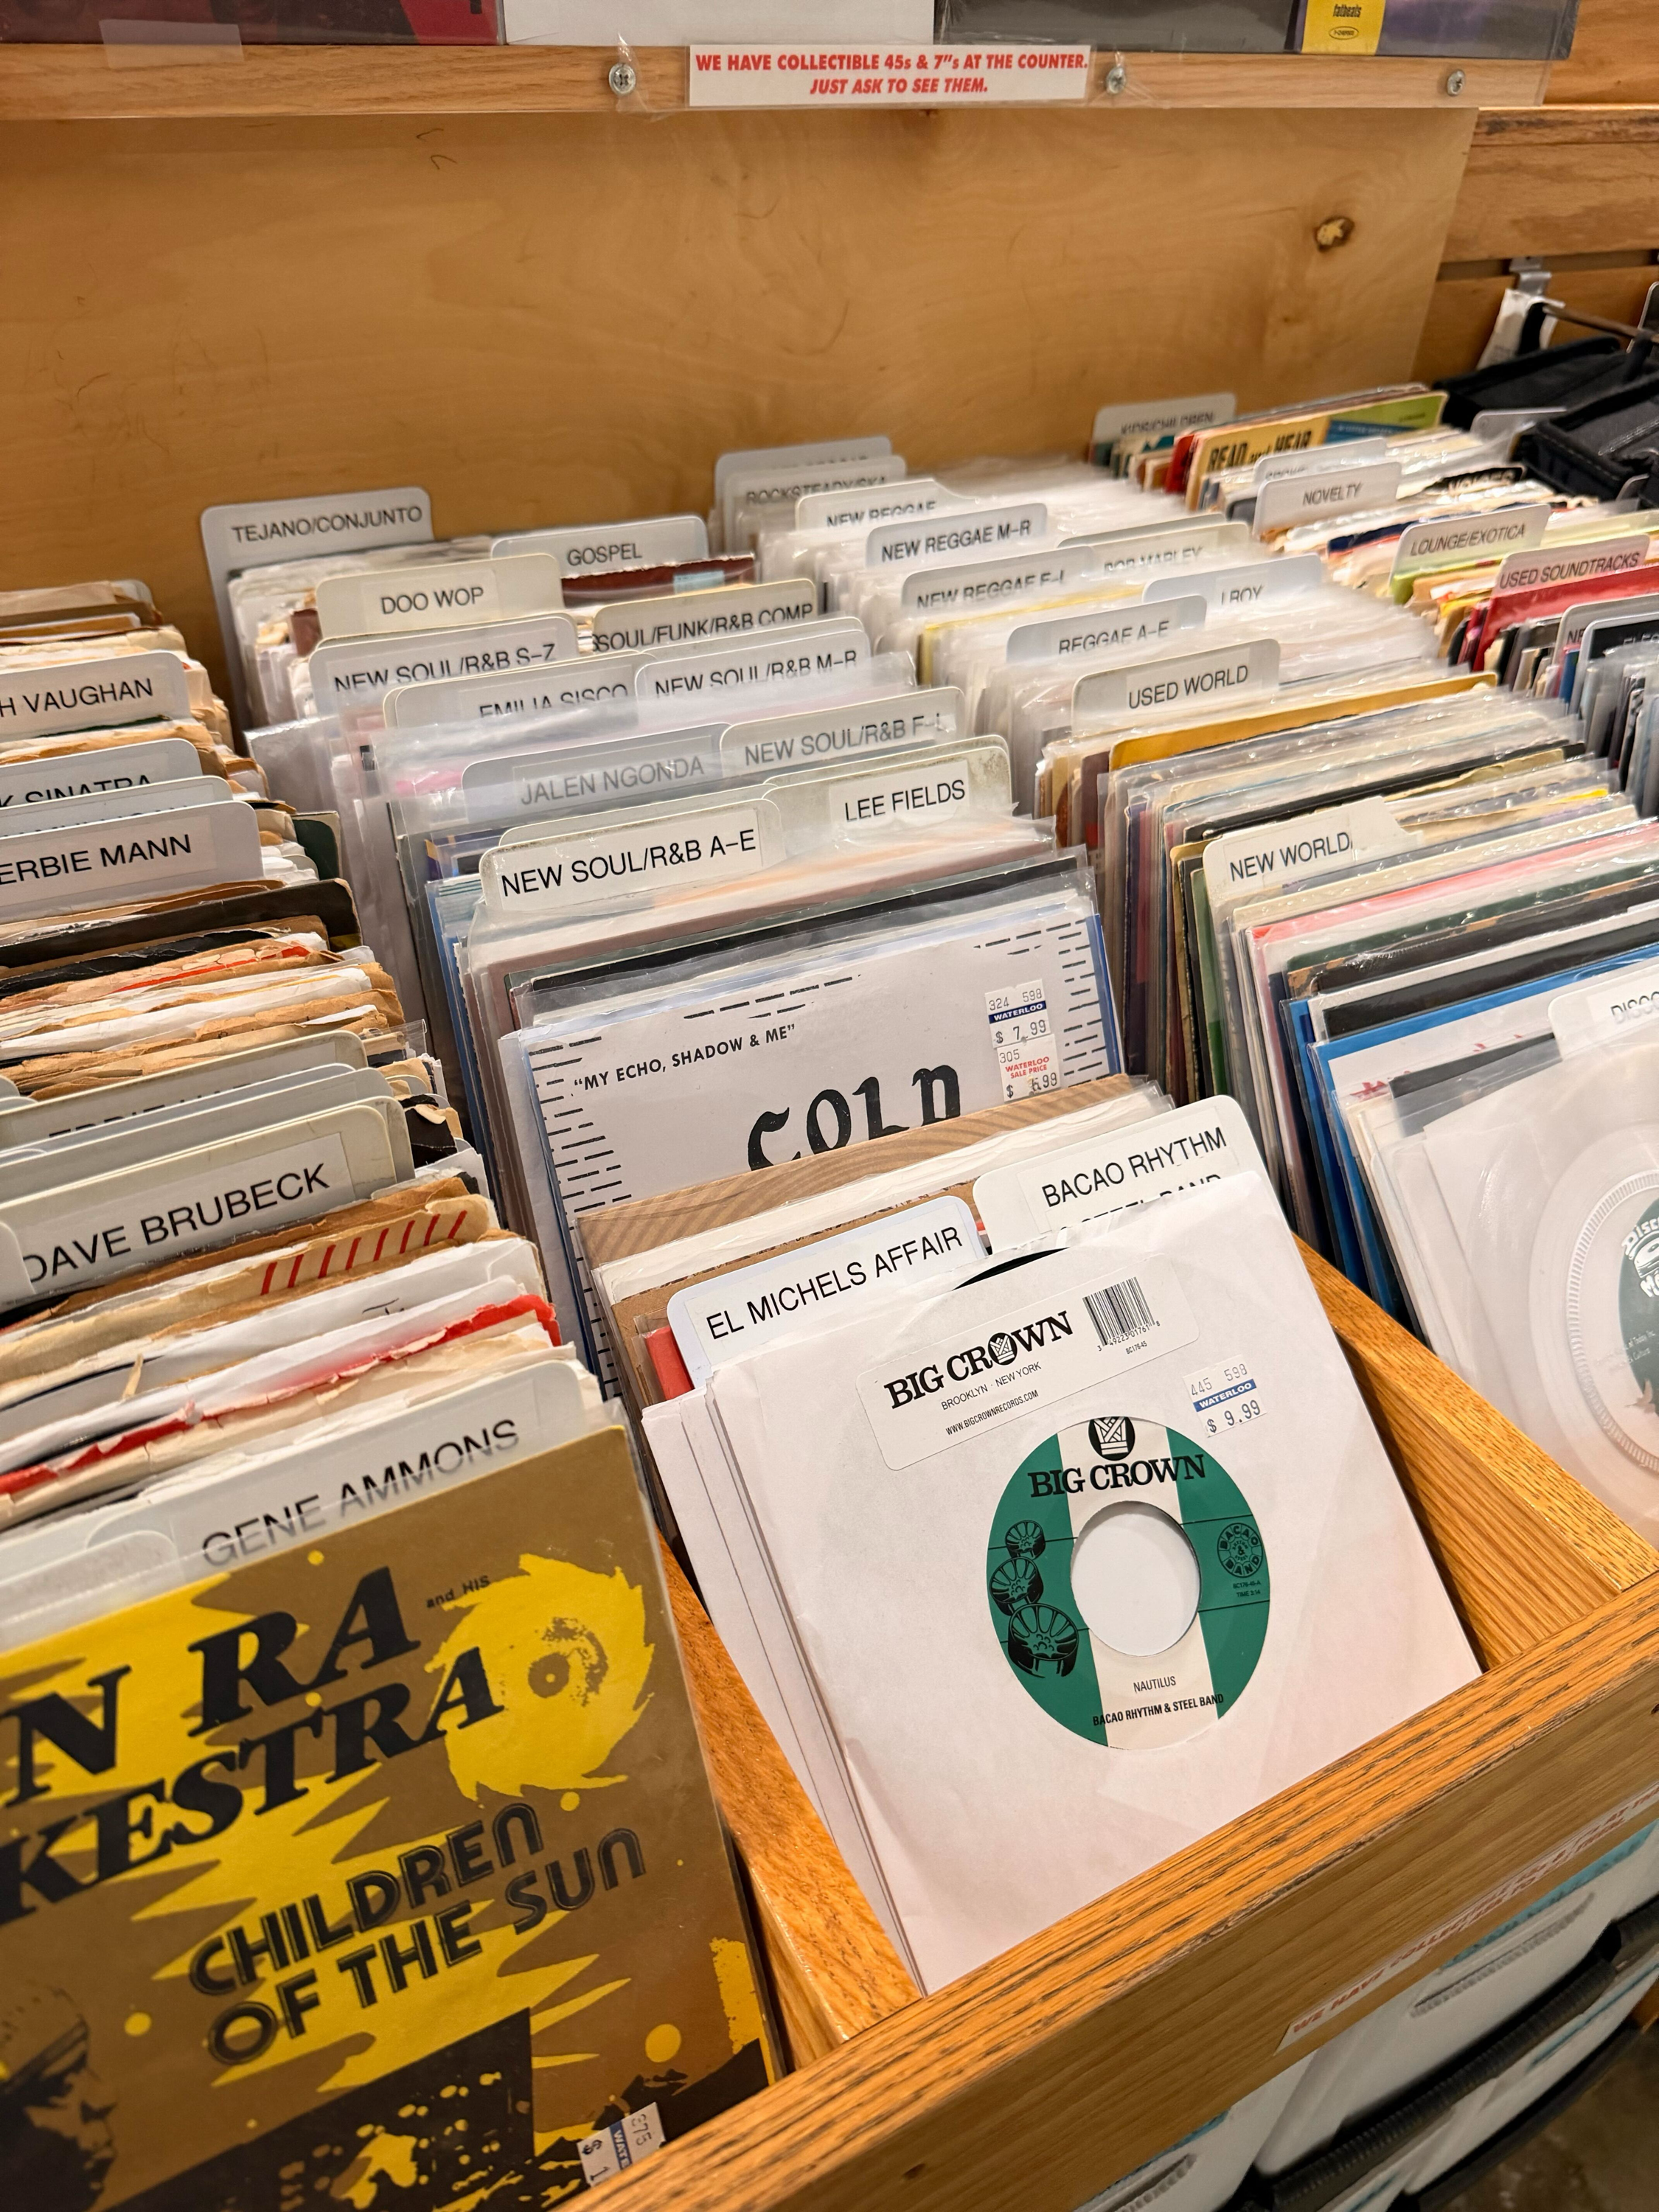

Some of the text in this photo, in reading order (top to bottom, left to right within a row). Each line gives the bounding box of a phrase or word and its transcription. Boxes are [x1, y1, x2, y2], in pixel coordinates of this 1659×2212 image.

[695, 55, 721, 71] WE
[728, 55, 771, 71] HAVE
[777, 54, 880, 70] COLLECTIBLE
[884, 54, 911, 70] 45s
[916, 54, 928, 69] &
[963, 54, 982, 69] AT
[987, 54, 1013, 69] THE
[1018, 53, 1088, 69] COUNTER.
[810, 77, 988, 94] JUST ASK TO SEE THEM.
[1302, 482, 1362, 506] NOVELTY
[232, 506, 422, 543] TEJANO/CONJUNTO
[881, 519, 1032, 563] NEW REGGAE M-R
[1410, 524, 1526, 556] LOUNGE/EXOTICA
[567, 543, 642, 566] GOSPEL
[1499, 552, 1640, 589] USED SOUNDTRACKS
[380, 586, 484, 615] DOO WOP
[917, 588, 958, 608] NEW
[962, 574, 1035, 603] REGGAE
[759, 603, 813, 627] COMP
[1059, 626, 1133, 655] REGGAE
[334, 642, 555, 692] NEW SOUL/R&B S-Z
[655, 674, 703, 698] NEW
[710, 658, 811, 687] SOUL/R&B
[23, 678, 153, 714] VAUGHAN
[1128, 664, 1248, 710] USED WORLD
[745, 739, 794, 766] NEW
[801, 720, 905, 757] SOUL/R&B
[521, 756, 705, 806] JALEN NGONDA
[846, 779, 966, 823] LEE FIELDS
[0, 834, 192, 886] ERBIE MANN
[501, 829, 757, 897] NEW SOUL/R&B A-E
[1230, 832, 1350, 882] NEW WORLD
[989, 988, 1043, 1011] 324 598
[994, 1004, 1043, 1021] WATERLOO
[995, 1031, 1004, 1044] $
[616, 1058, 667, 1082] ECHO,
[672, 1037, 742, 1068] SHADOW
[750, 1034, 760, 1047] &
[999, 1048, 1020, 1064] 305
[1005, 1056, 1049, 1073] WATERLOO
[1010, 1064, 1047, 1079] SALE PRICE
[1006, 1084, 1014, 1099] $
[1042, 1162, 1124, 1208] BACAO
[1127, 1127, 1227, 1178] RHYTHM
[23, 1163, 330, 1284] DAVE BRUBECK
[706, 1225, 963, 1340] EL MICHELS AFFAIR
[884, 1310, 1074, 1410] BIG CROWN
[941, 1361, 1042, 1411] BROOKLYN NEW YORK
[1191, 1363, 1248, 1396] 445 598
[1199, 1382, 1252, 1408] WATERLOO
[945, 1390, 1039, 1436] WWW.BIGCROWNRECORDS.COM
[1207, 1399, 1260, 1433] $ 9.99
[201, 1419, 520, 1568] GENE AMMONS
[1027, 1453, 1206, 1498] BIG CROWN
[1220, 1526, 1258, 1549] BACAO
[1238, 1545, 1245, 1556] &
[1225, 1556, 1259, 1576] BAND
[426, 1574, 492, 1608] and HIS
[187, 1565, 422, 1739] RA
[1133, 1676, 1177, 1694] NAUTILUS
[1093, 1693, 1224, 1727] BACAO RHYTHM & STEEL BAND
[0, 1646, 504, 1919] KESTRA
[189, 1803, 543, 1996] CHILDREN
[207, 1827, 647, 2065] OF THE SUN
[582, 2139, 603, 2155] $
[613, 2129, 630, 2169] WATE
